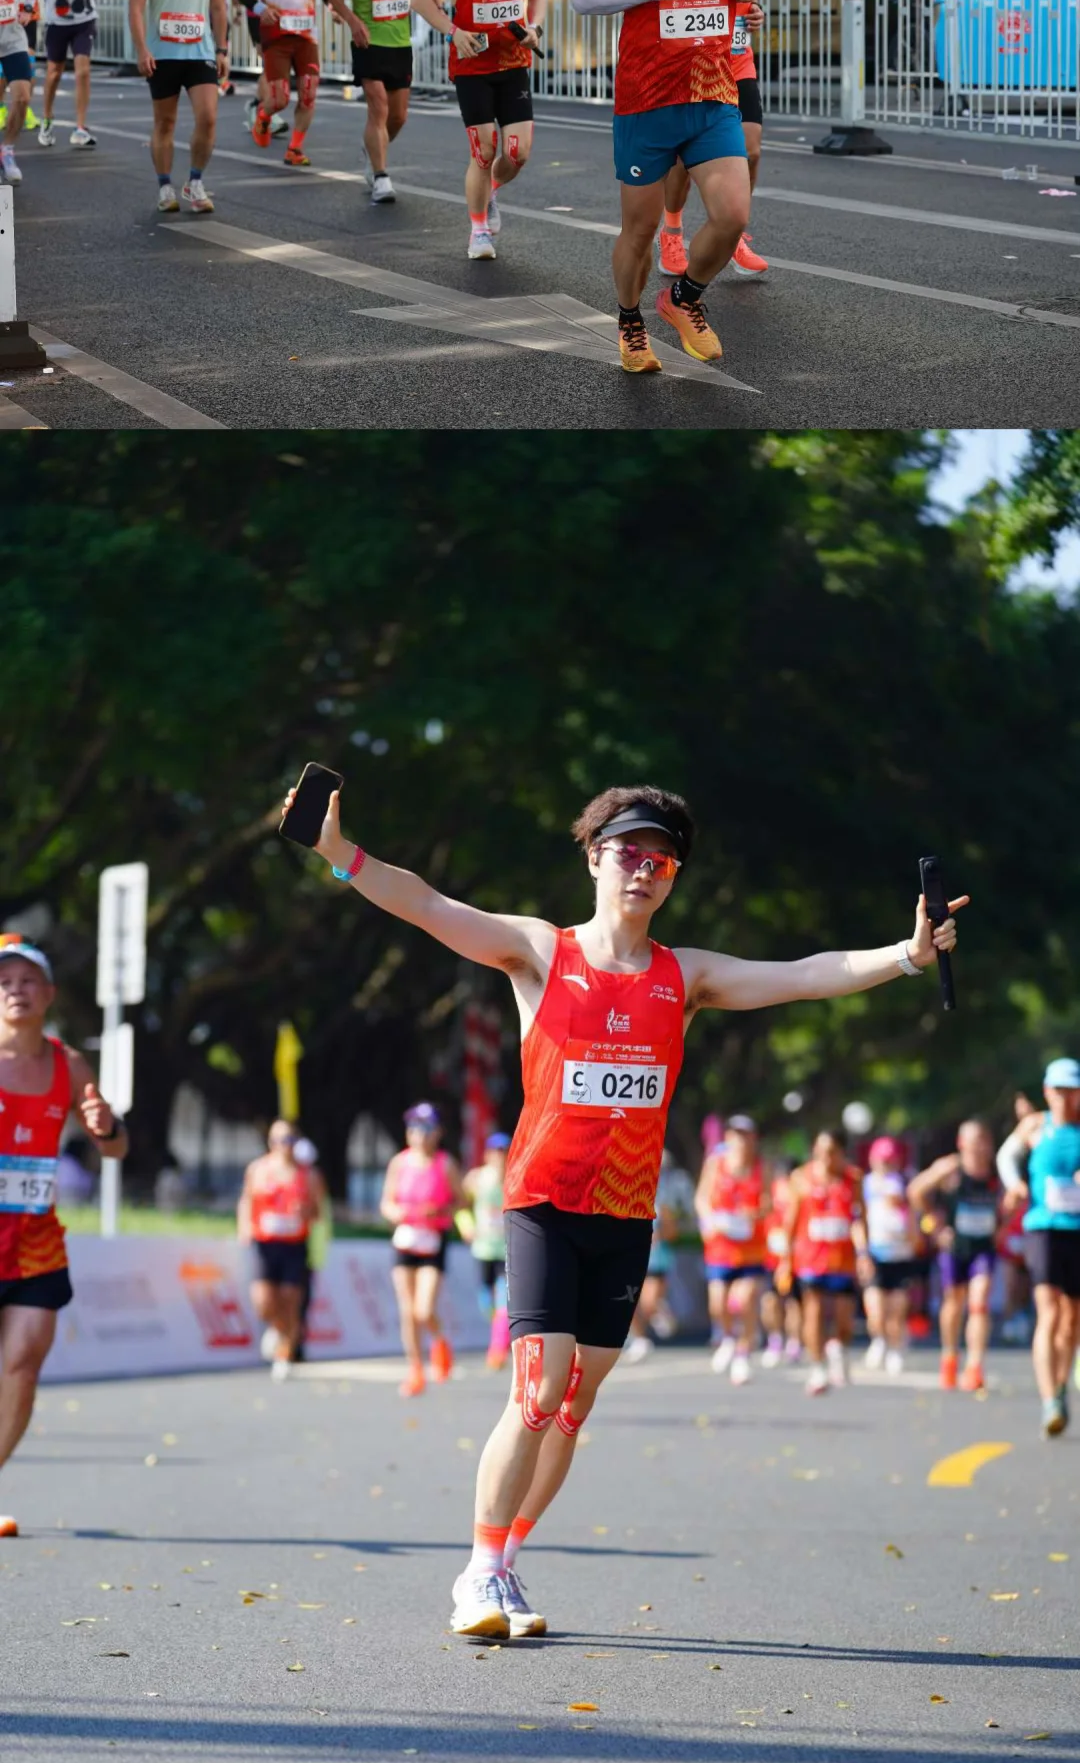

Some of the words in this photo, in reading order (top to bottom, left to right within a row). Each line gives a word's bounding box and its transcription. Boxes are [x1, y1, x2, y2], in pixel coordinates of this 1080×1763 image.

[386, 0, 409, 14] 1496
[476, 7, 484, 17] C
[491, 4, 520, 20] 0216
[666, 15, 675, 28] C
[684, 12, 725, 32] 2349
[174, 24, 201, 36] 3030
[731, 31, 747, 45] 58
[572, 1070, 585, 1087] C
[601, 1072, 658, 1100] 0216
